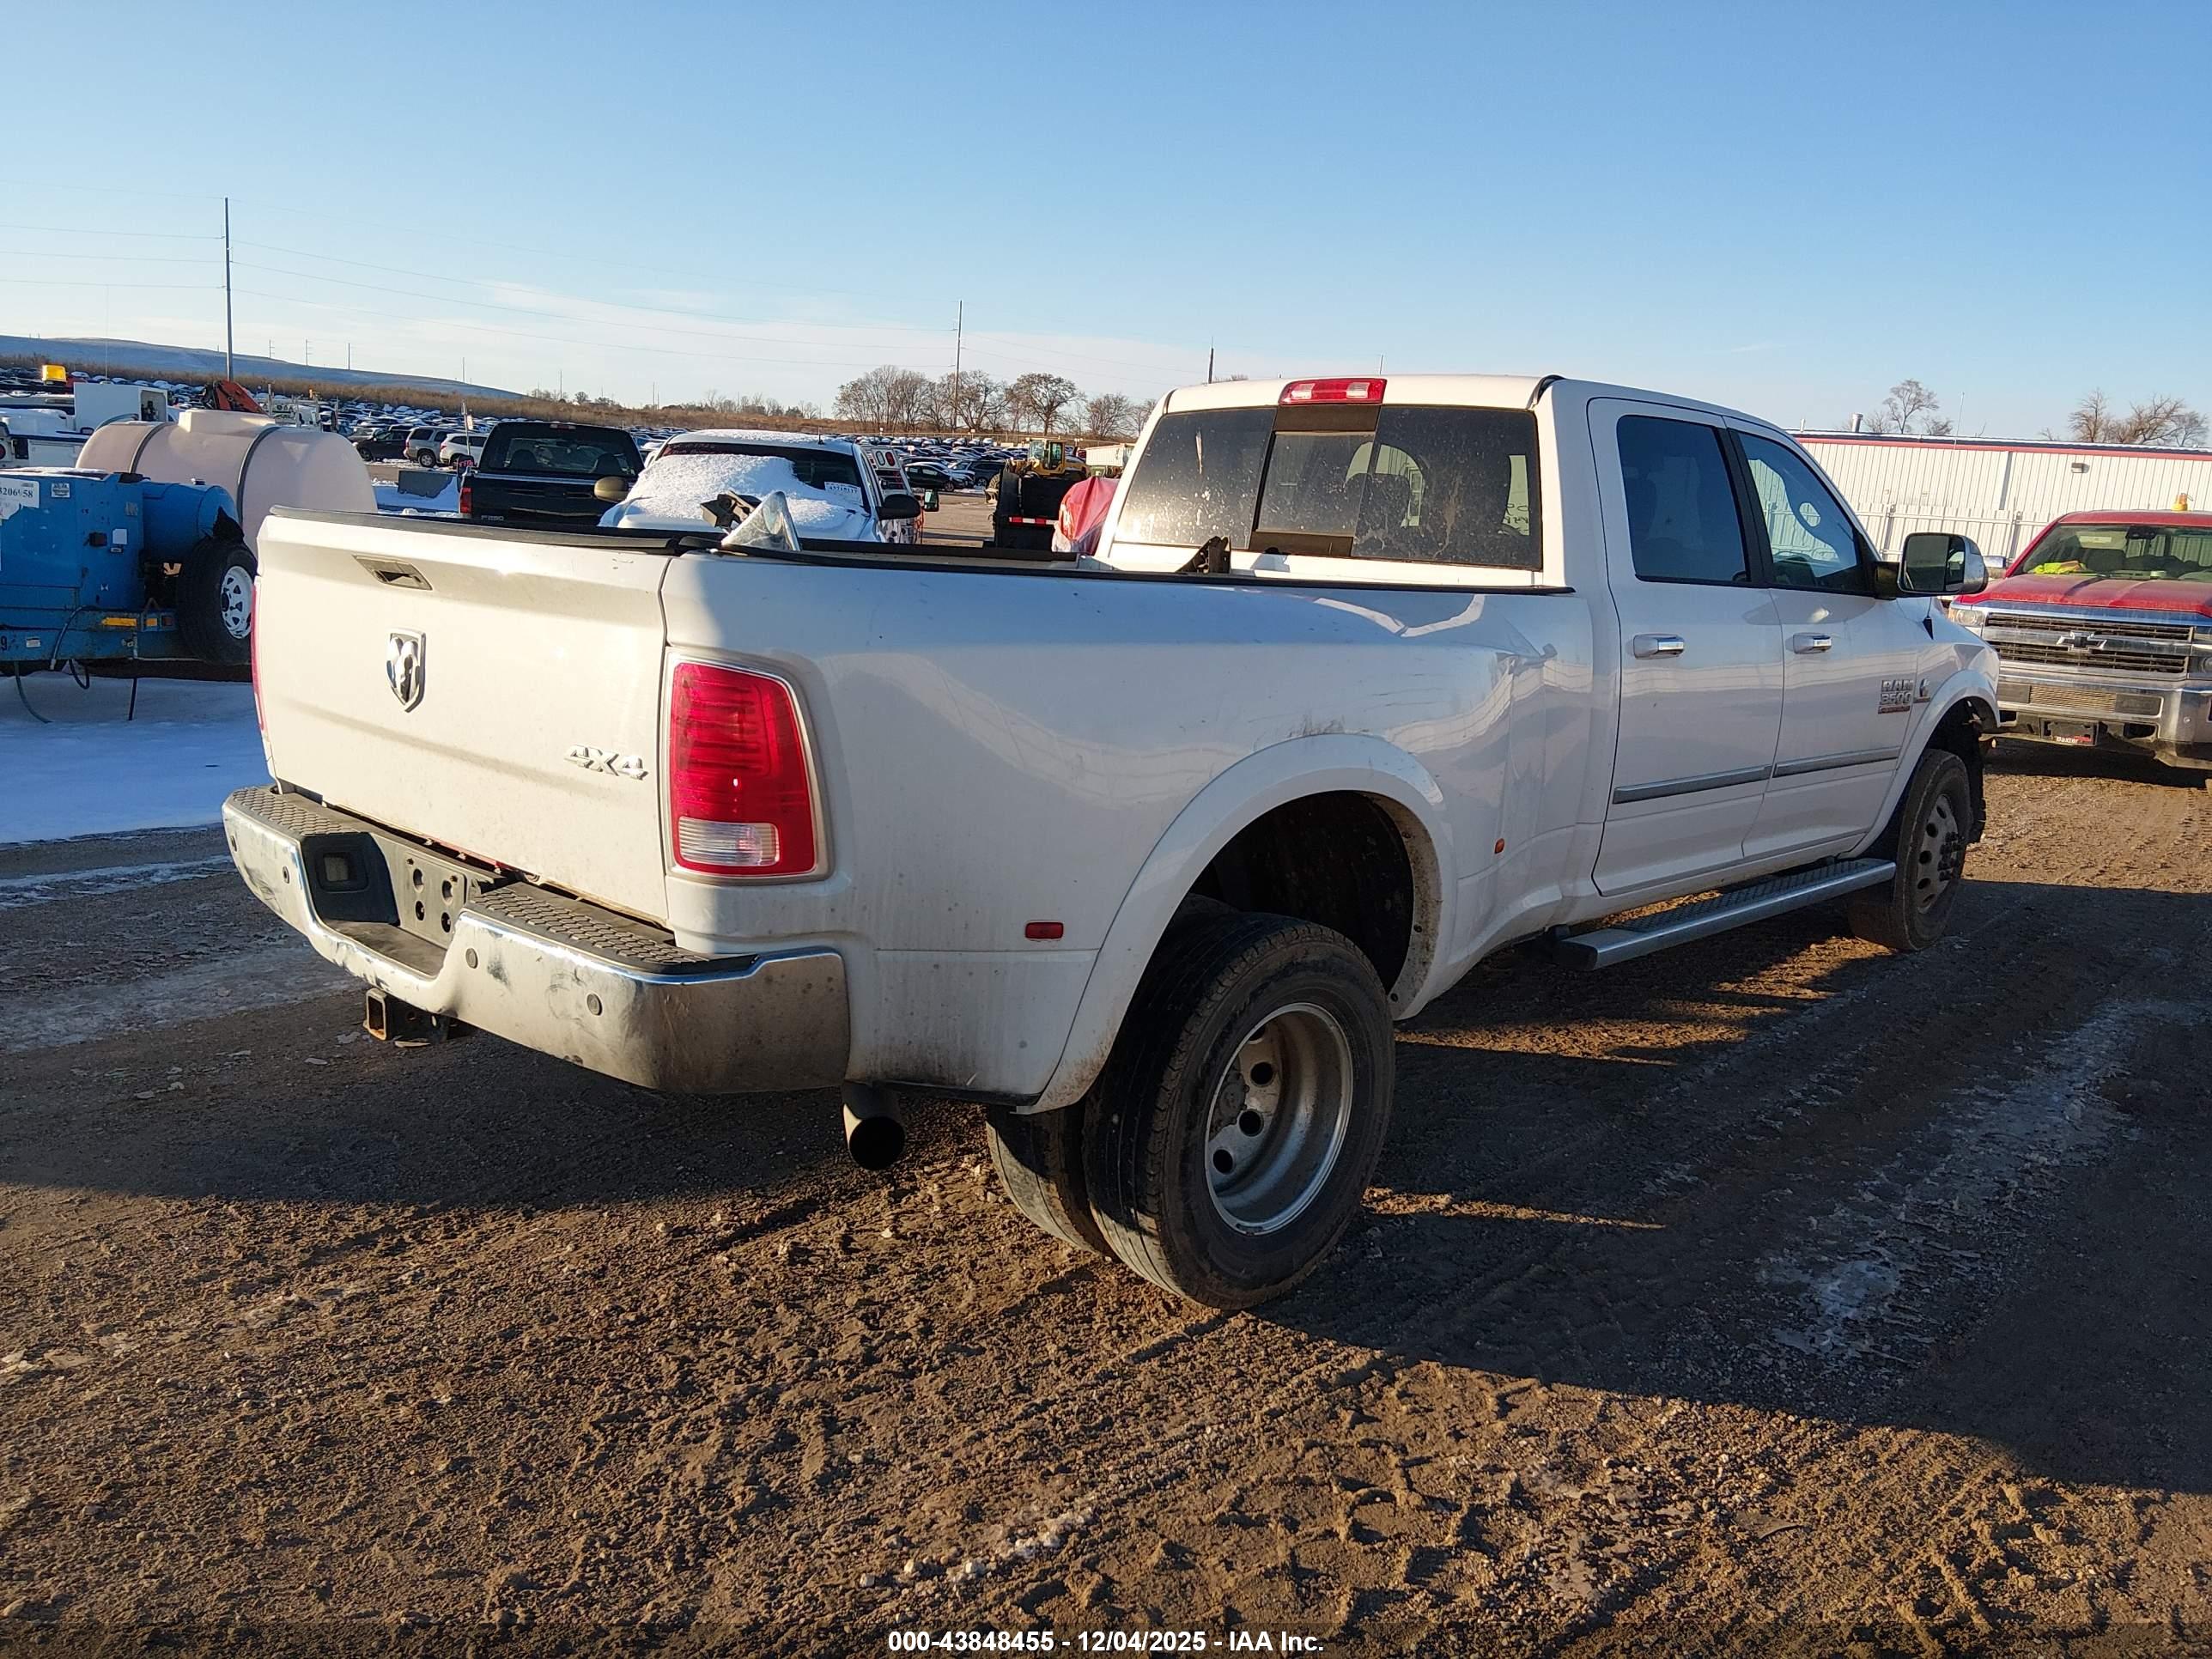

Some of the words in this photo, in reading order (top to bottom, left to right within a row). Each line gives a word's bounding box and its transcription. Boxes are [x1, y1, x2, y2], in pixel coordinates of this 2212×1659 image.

[1881, 679, 1914, 691] RAM
[1881, 692, 1911, 705] 3500
[2056, 736, 2078, 744] Baxter
